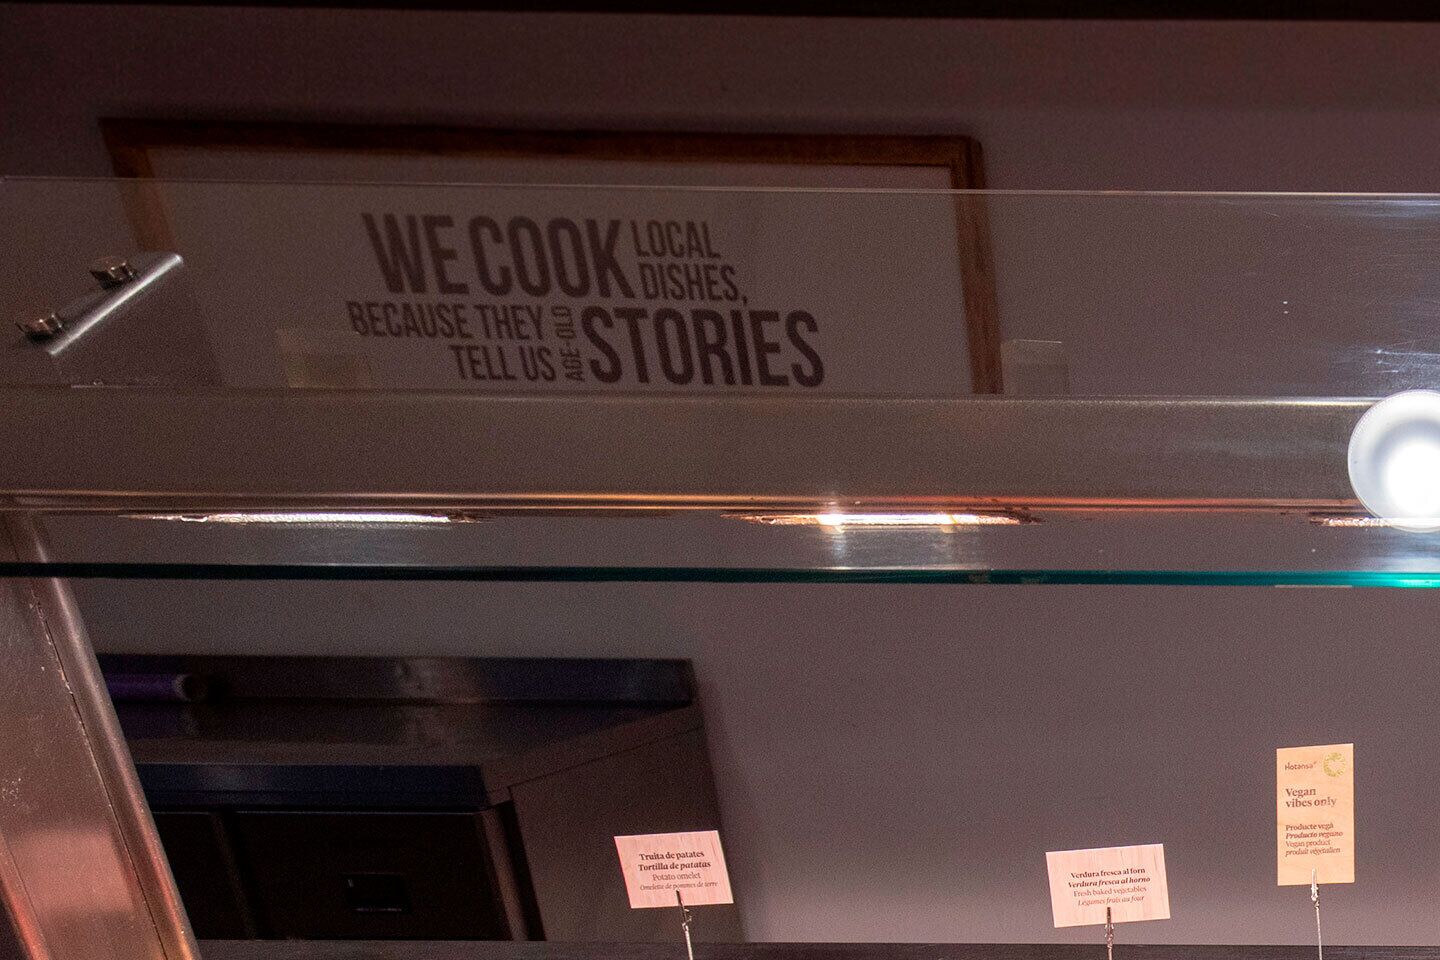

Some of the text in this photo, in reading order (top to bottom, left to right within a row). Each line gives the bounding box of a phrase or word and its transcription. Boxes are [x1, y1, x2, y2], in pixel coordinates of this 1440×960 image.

[630, 219, 722, 259] LOCAL
[361, 212, 636, 299] WE COOK
[638, 262, 748, 304] DISHES,
[346, 301, 545, 341] BECAUSE THEY
[551, 305, 586, 382] AGE-OLD
[580, 305, 826, 388] STORIES
[448, 343, 557, 382] TELL US
[1285, 788, 1316, 798] Vegan
[1285, 796, 1337, 808] vibes only
[1285, 823, 1317, 831] Producte
[639, 851, 705, 861] Truita de patates
[638, 861, 711, 871] Tortilla de patatas
[652, 872, 701, 881] Potato omelet
[1070, 871, 1100, 879] Verdura
[1100, 869, 1121, 877] fresca
[1130, 867, 1146, 875] forn
[1068, 880, 1098, 888] Verdura
[1098, 879, 1120, 887] fresca
[1129, 876, 1151, 884] horno
[1073, 886, 1147, 897] Fresh baked vegetables
